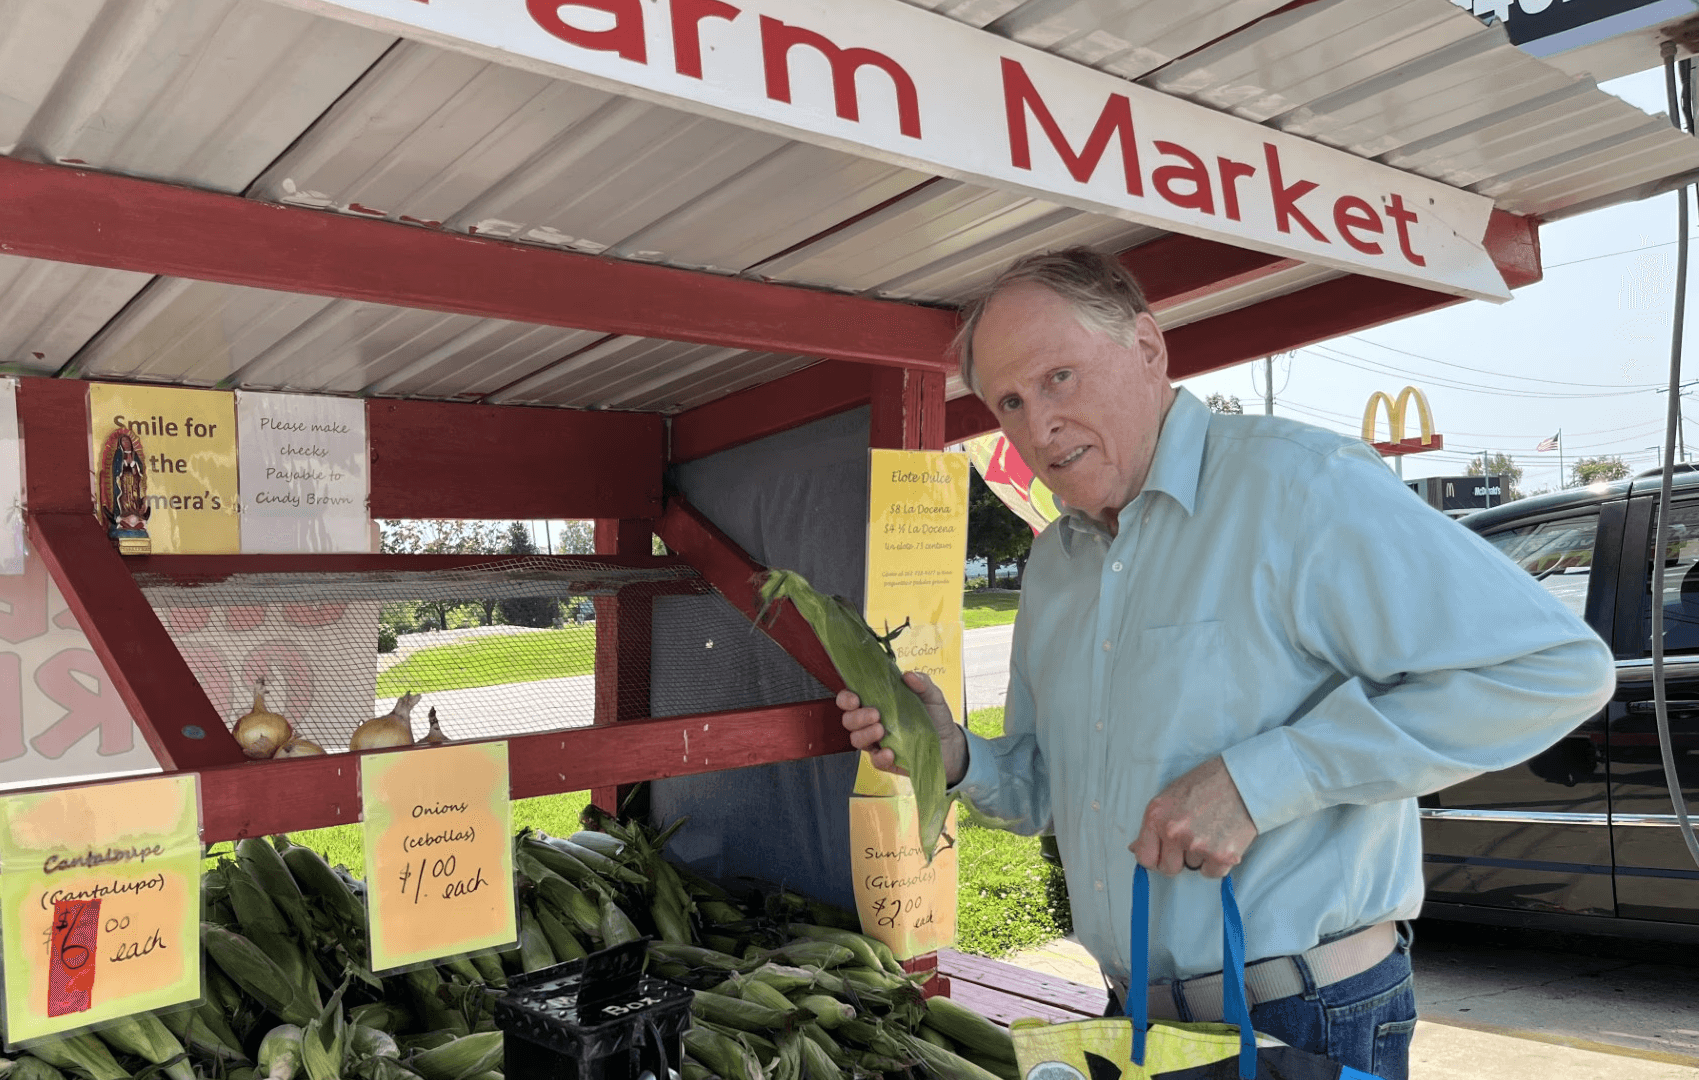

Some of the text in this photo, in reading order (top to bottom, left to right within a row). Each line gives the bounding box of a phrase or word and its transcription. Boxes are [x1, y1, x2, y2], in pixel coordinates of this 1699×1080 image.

[413, 0, 1427, 267] arm Market
[114, 414, 217, 438] Smile for
[260, 417, 350, 434] Please make
[280, 444, 329, 458] checks
[149, 453, 187, 474] the
[265, 467, 345, 483] Payable to
[892, 469, 952, 484] Elote Dulce
[146, 491, 221, 510] mera's
[255, 491, 353, 507] Cindy Brown
[903, 503, 916, 514] La
[917, 503, 952, 514] Docena
[908, 523, 921, 534] La
[921, 523, 956, 534] Docena
[412, 802, 468, 818] Onions
[403, 827, 475, 852] (cebollas)
[865, 845, 922, 861] Sunflow
[442, 868, 489, 899] each
[865, 867, 936, 890] (Girasoles)
[41, 873, 164, 910] (Cantalupo)
[109, 928, 166, 962] each
[602, 997, 662, 1016] Box
